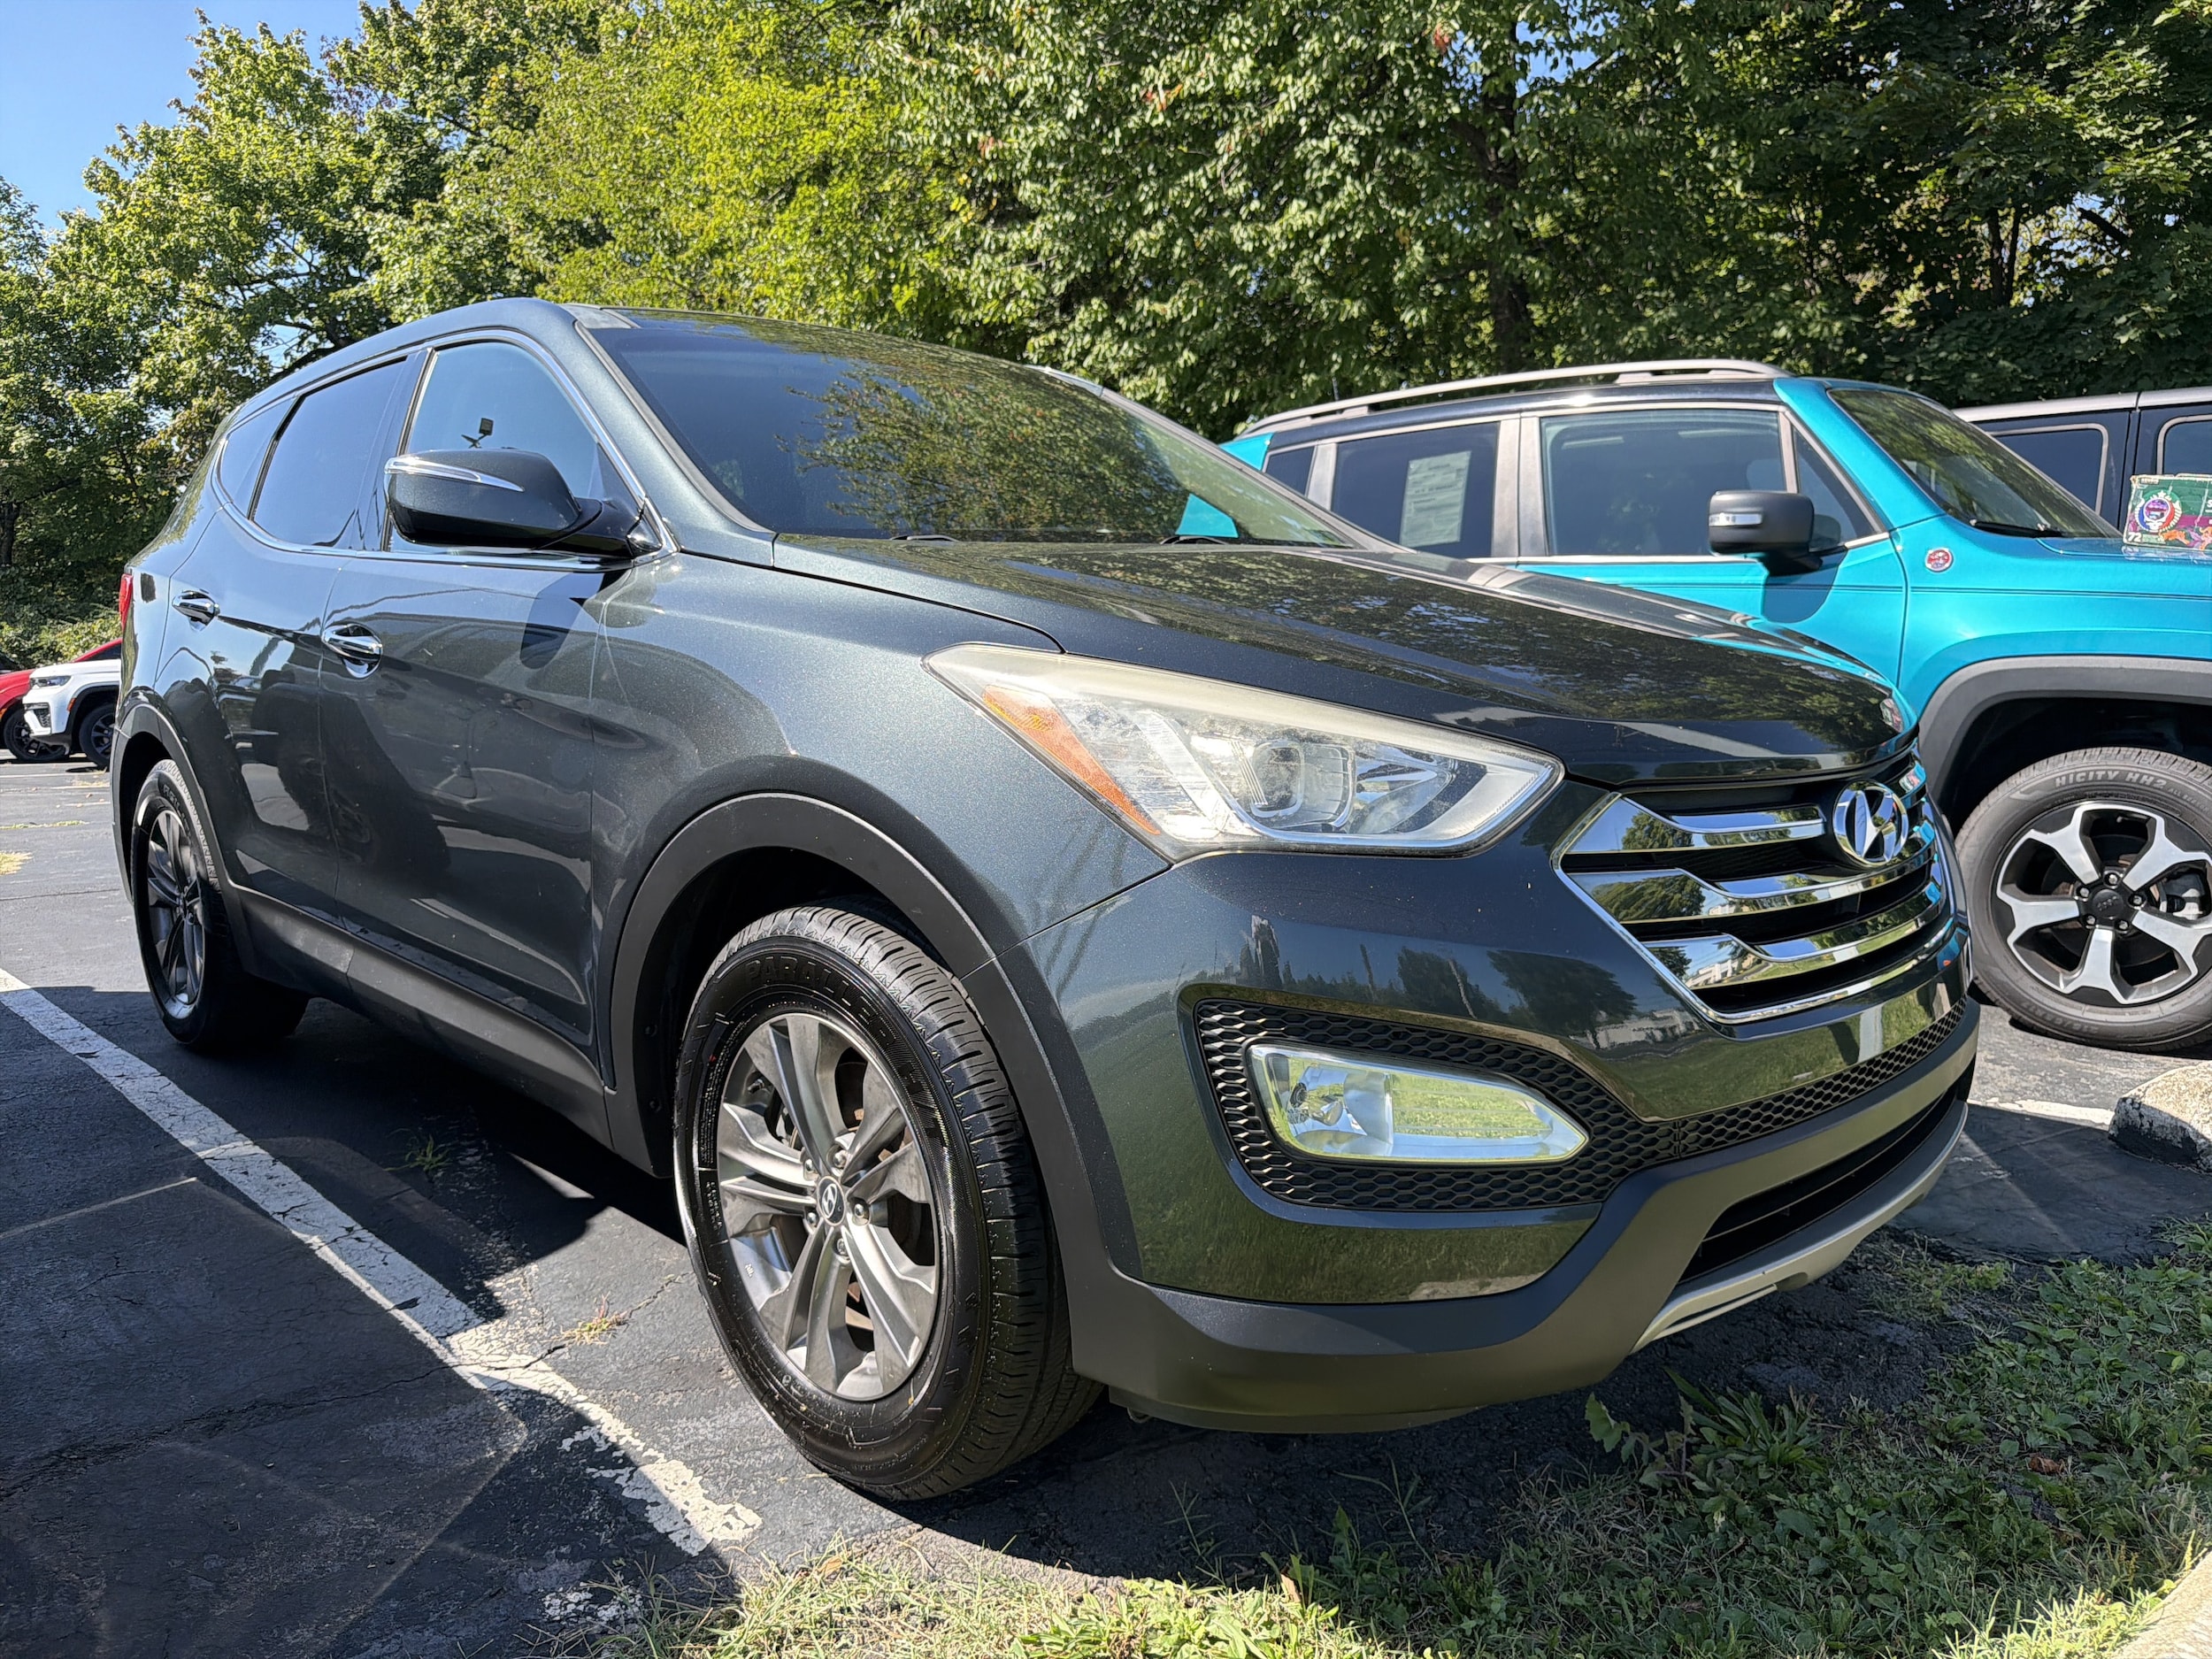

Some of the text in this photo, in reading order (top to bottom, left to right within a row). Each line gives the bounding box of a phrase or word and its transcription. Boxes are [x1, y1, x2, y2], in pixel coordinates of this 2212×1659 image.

[2128, 532, 2142, 542] 72
[2055, 771, 2167, 789] HICITY HH2
[2168, 787, 2181, 796] ALL
[745, 955, 899, 1048] PARALLER
